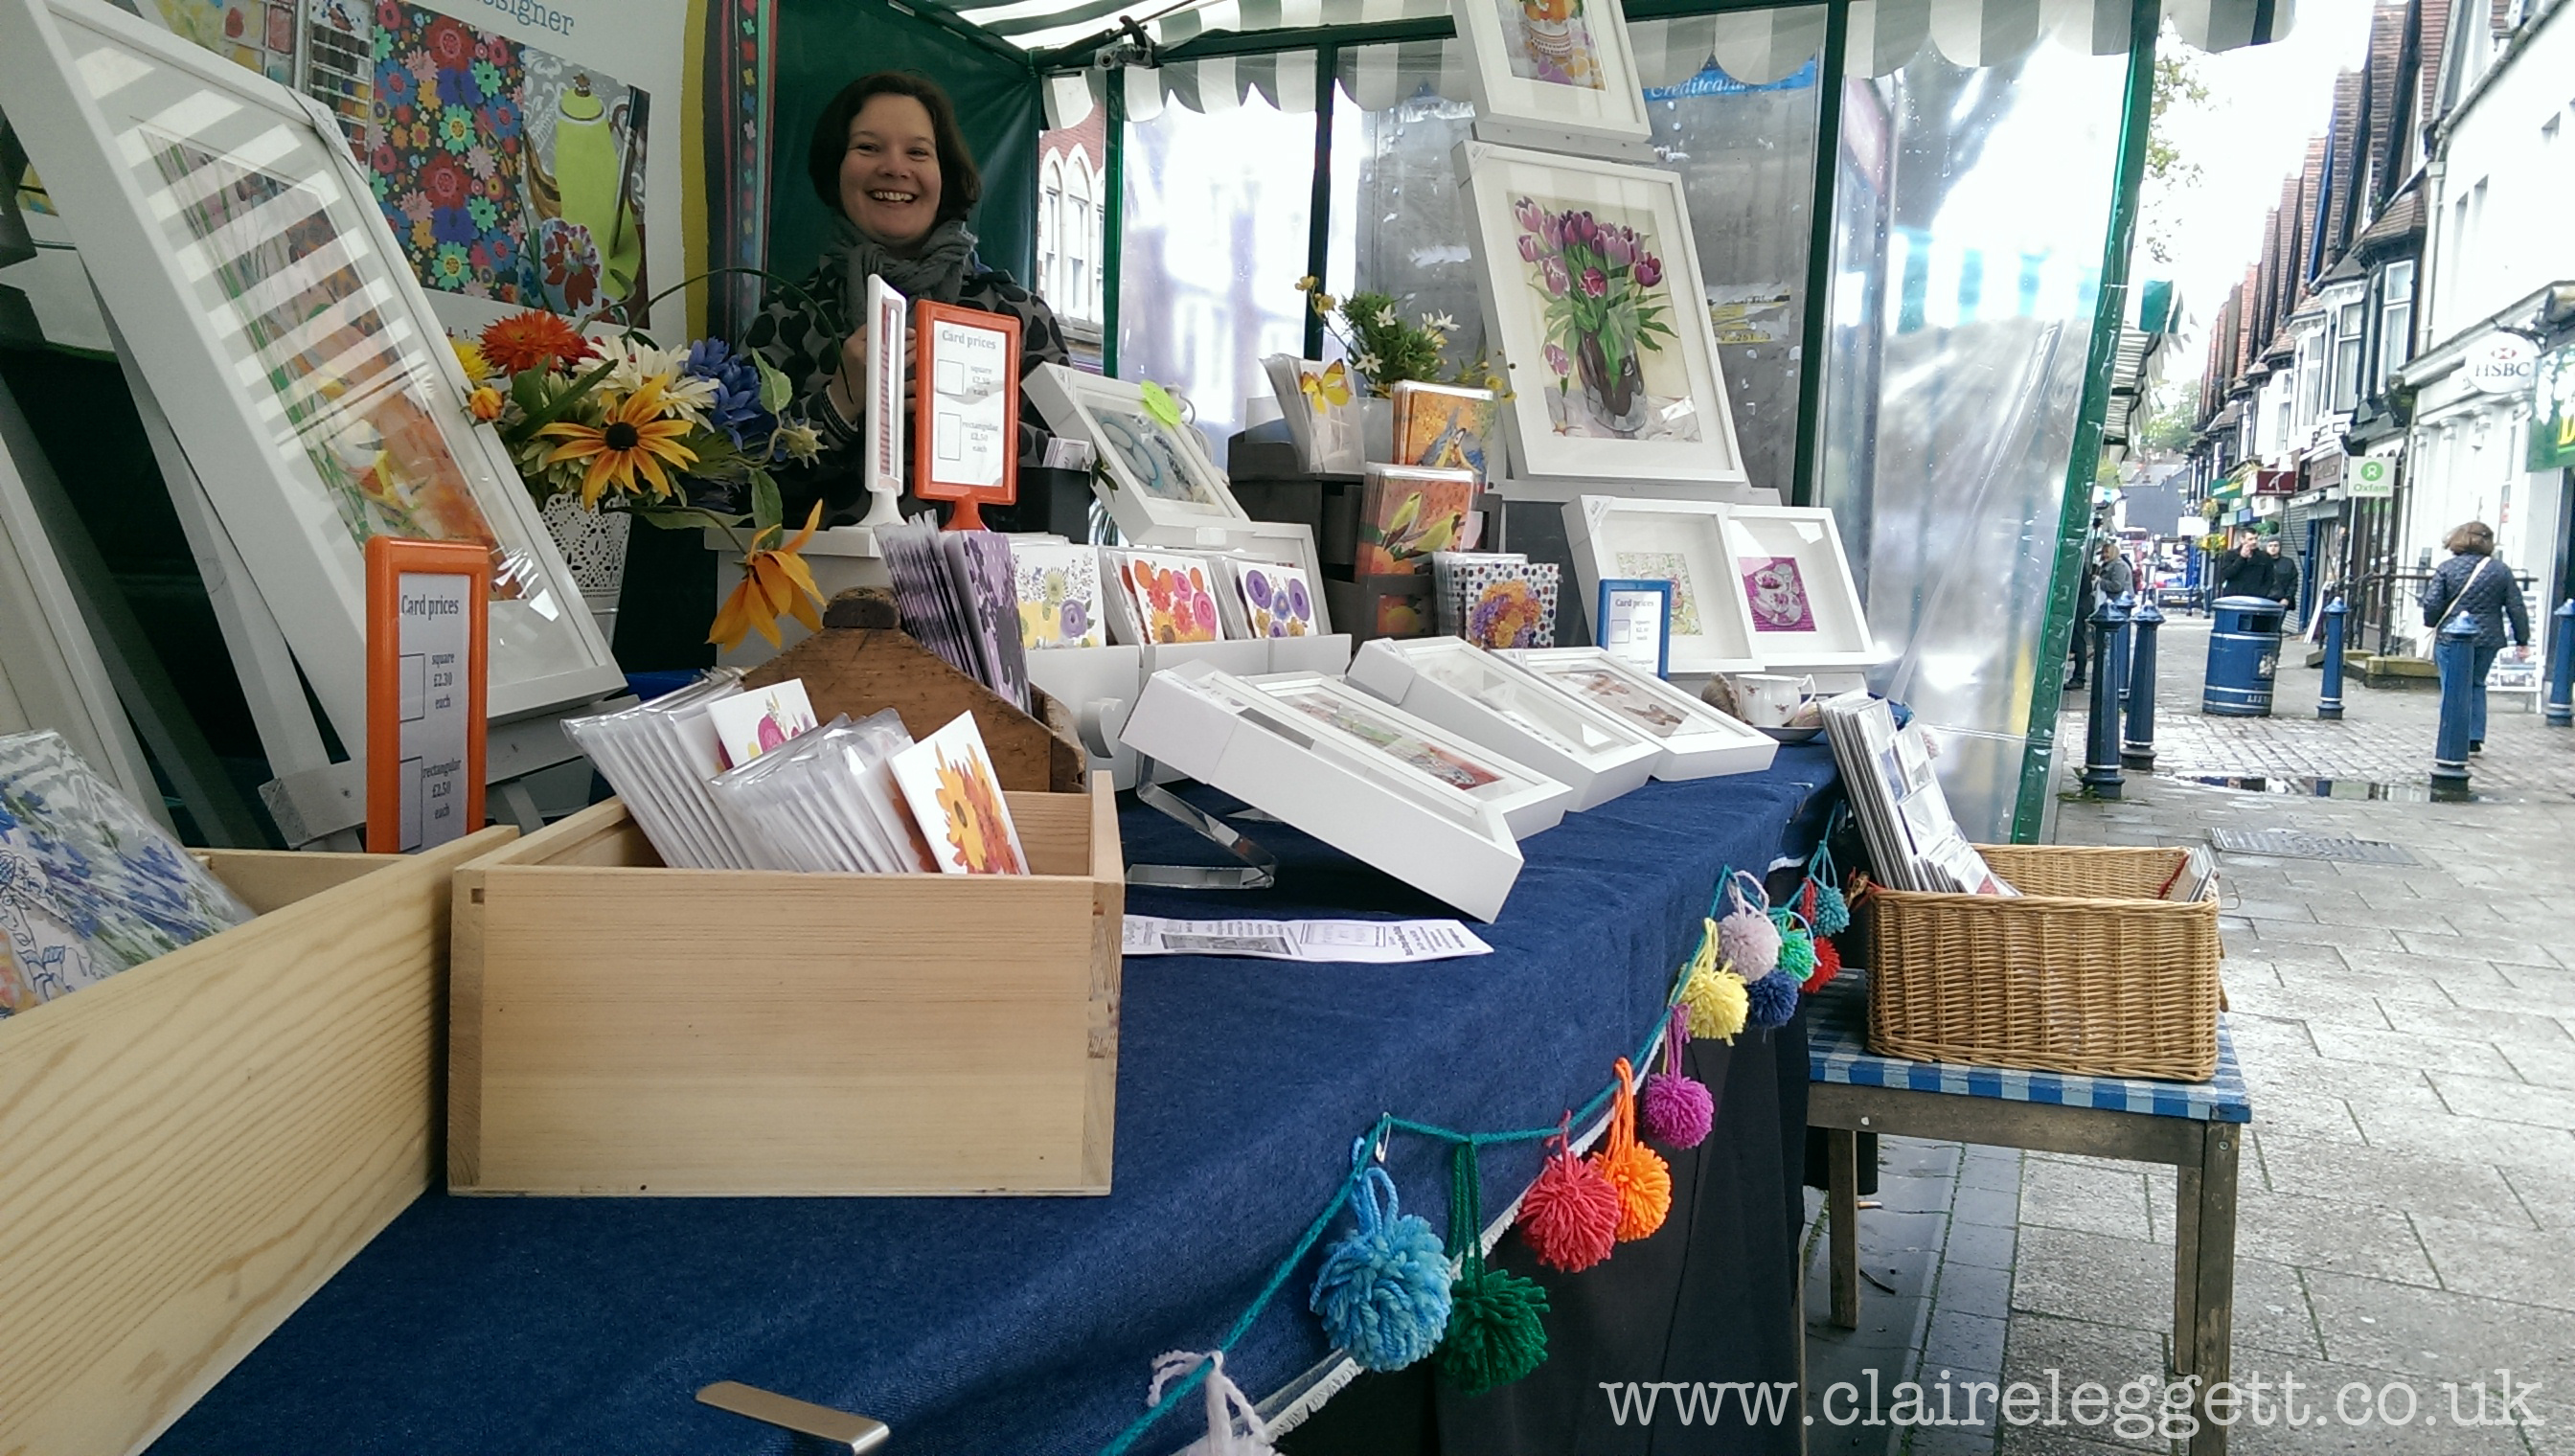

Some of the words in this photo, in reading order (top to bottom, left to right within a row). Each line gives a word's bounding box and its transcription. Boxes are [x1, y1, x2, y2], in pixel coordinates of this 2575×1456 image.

[483, 0, 574, 35] signer
[942, 330, 965, 345] Card
[967, 335, 996, 351] prices
[970, 364, 992, 375] square
[2475, 361, 2531, 376] HSBC
[973, 387, 989, 397] each
[962, 421, 998, 433] rectangular
[972, 444, 988, 453] each
[2353, 483, 2388, 491] Oxfam
[401, 594, 426, 615] Card
[428, 598, 460, 620] prices
[1615, 599, 1631, 607] Card
[1632, 599, 1654, 609] prices
[431, 652, 455, 668] square
[433, 672, 453, 688] £2.30
[435, 696, 451, 710] each
[422, 758, 462, 779] rectangular
[432, 781, 451, 799] £2.50
[434, 805, 450, 820] each
